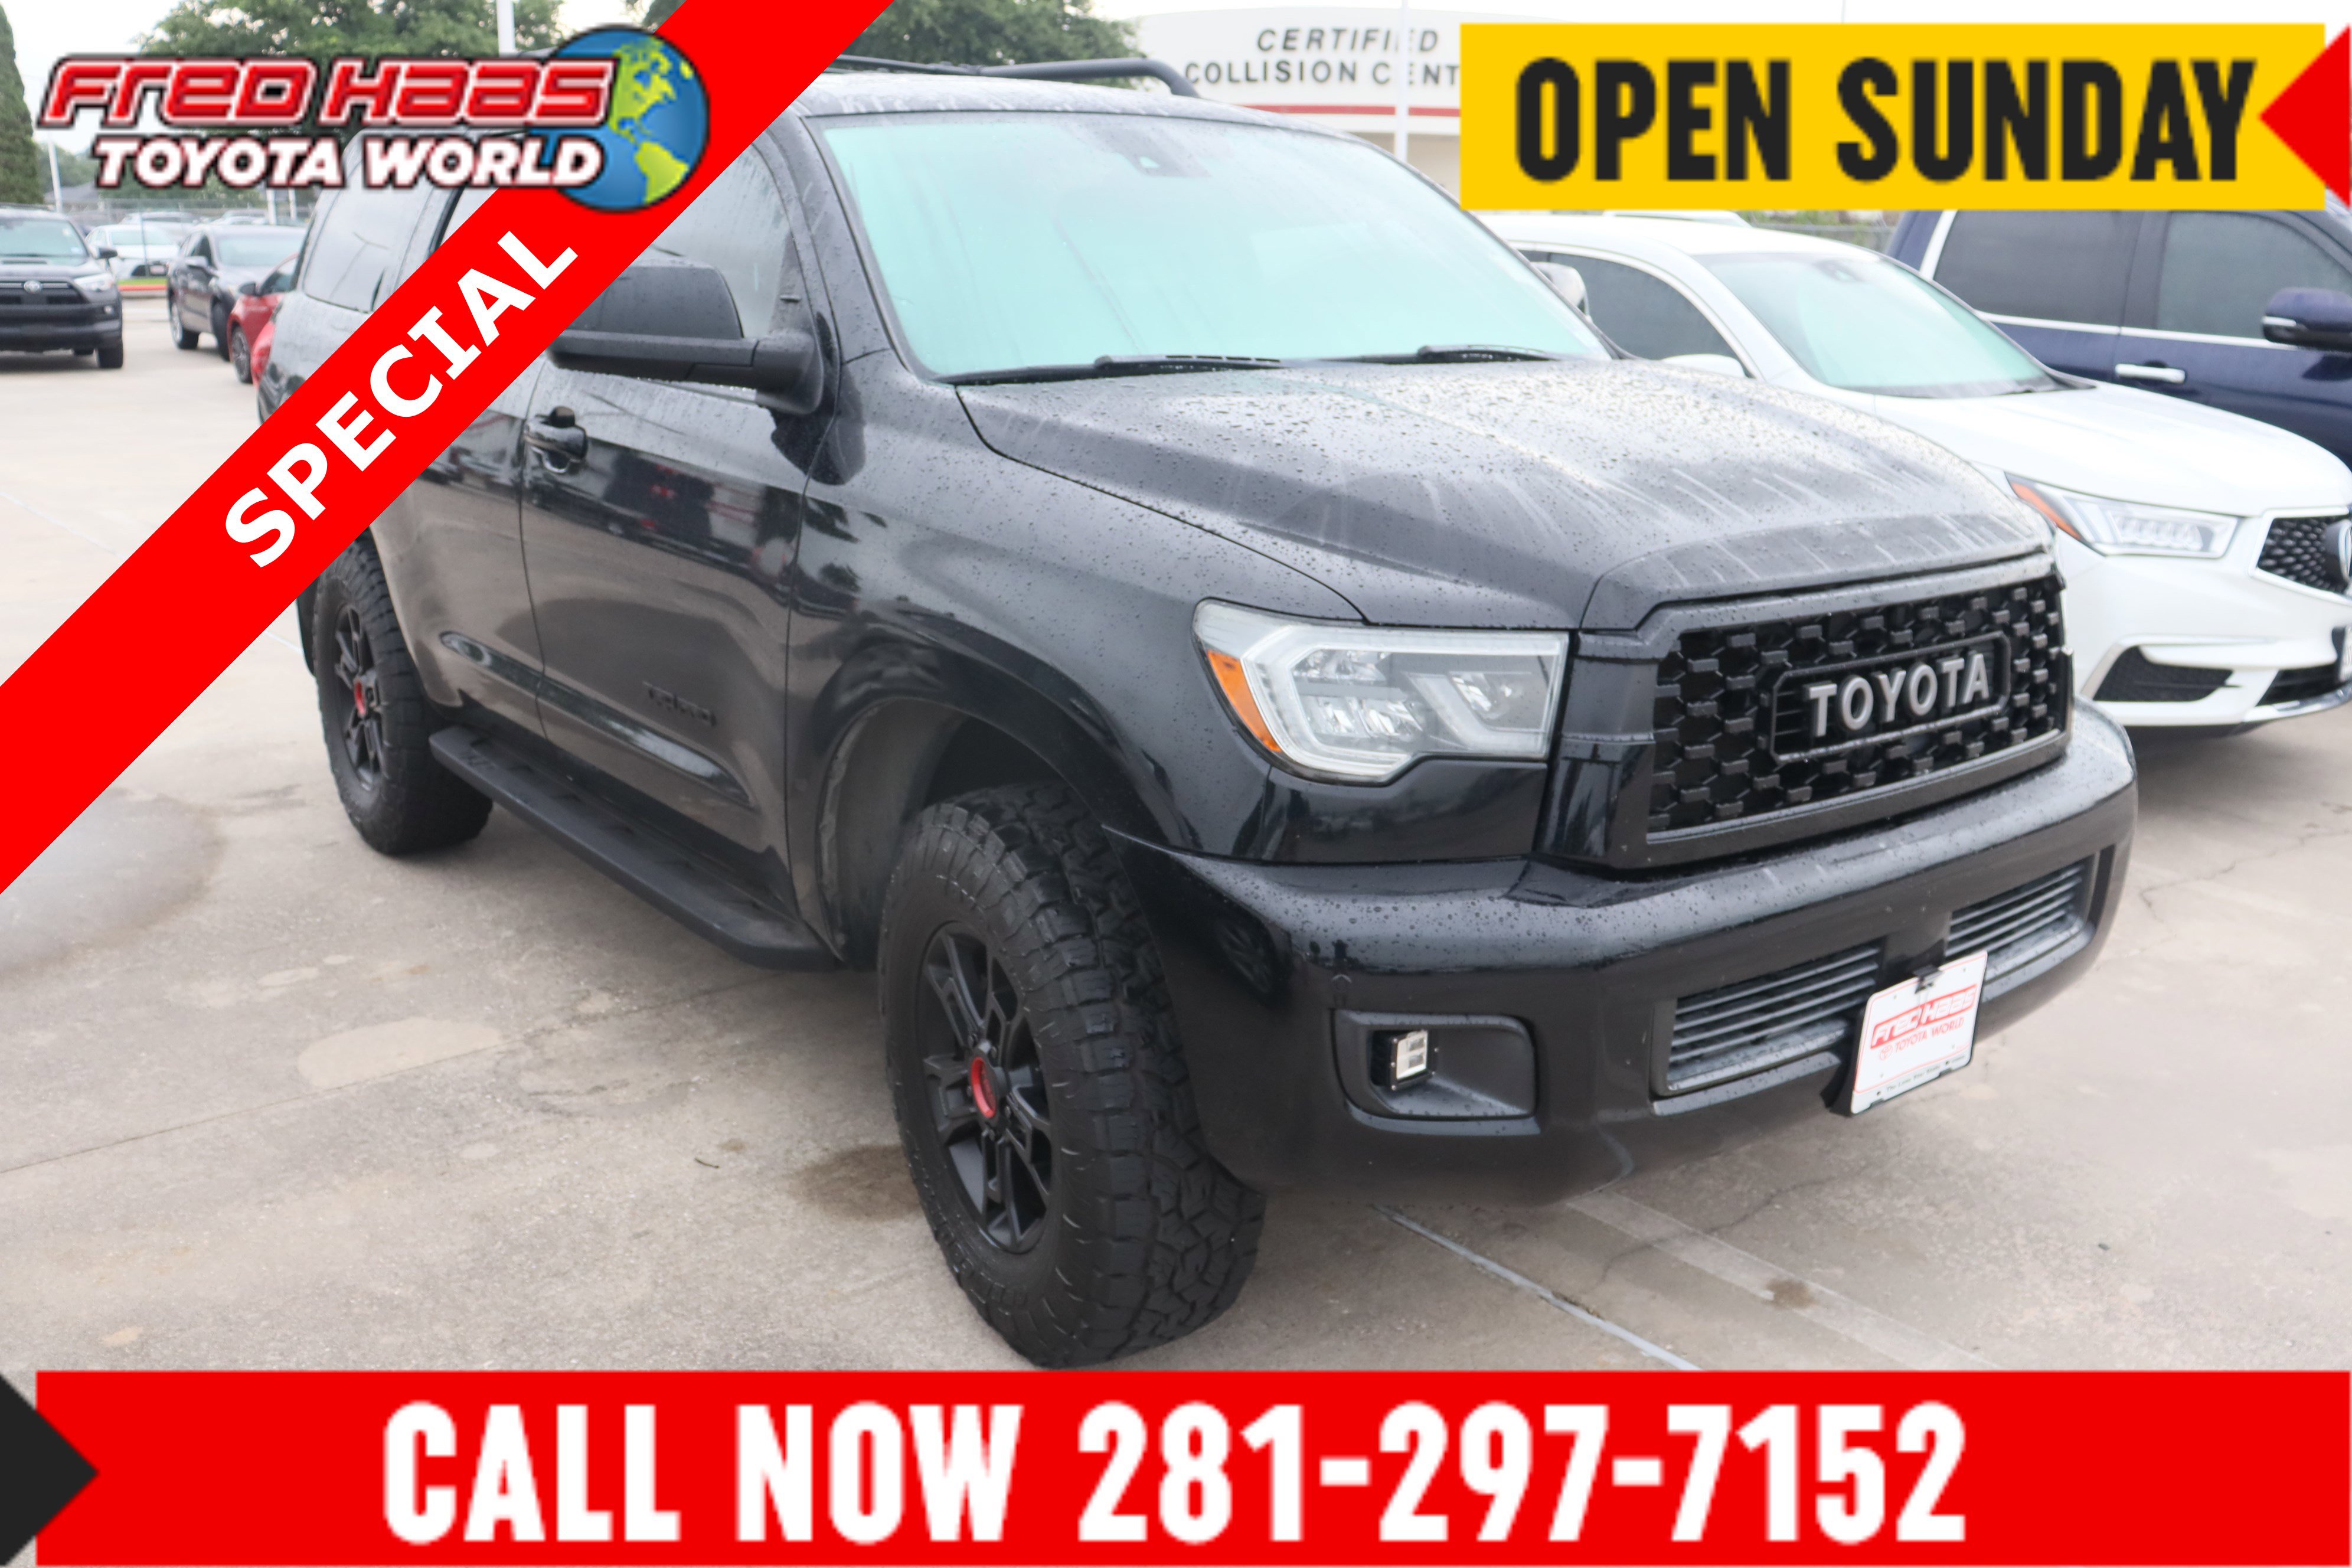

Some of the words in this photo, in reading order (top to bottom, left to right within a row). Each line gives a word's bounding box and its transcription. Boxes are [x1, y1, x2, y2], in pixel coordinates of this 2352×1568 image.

[1186, 61, 1357, 84] COLLISION
[1804, 652, 1989, 737] TOYOTA
[1896, 1031, 1928, 1053] TOYOTA
[1932, 1017, 1964, 1037] WORLD
